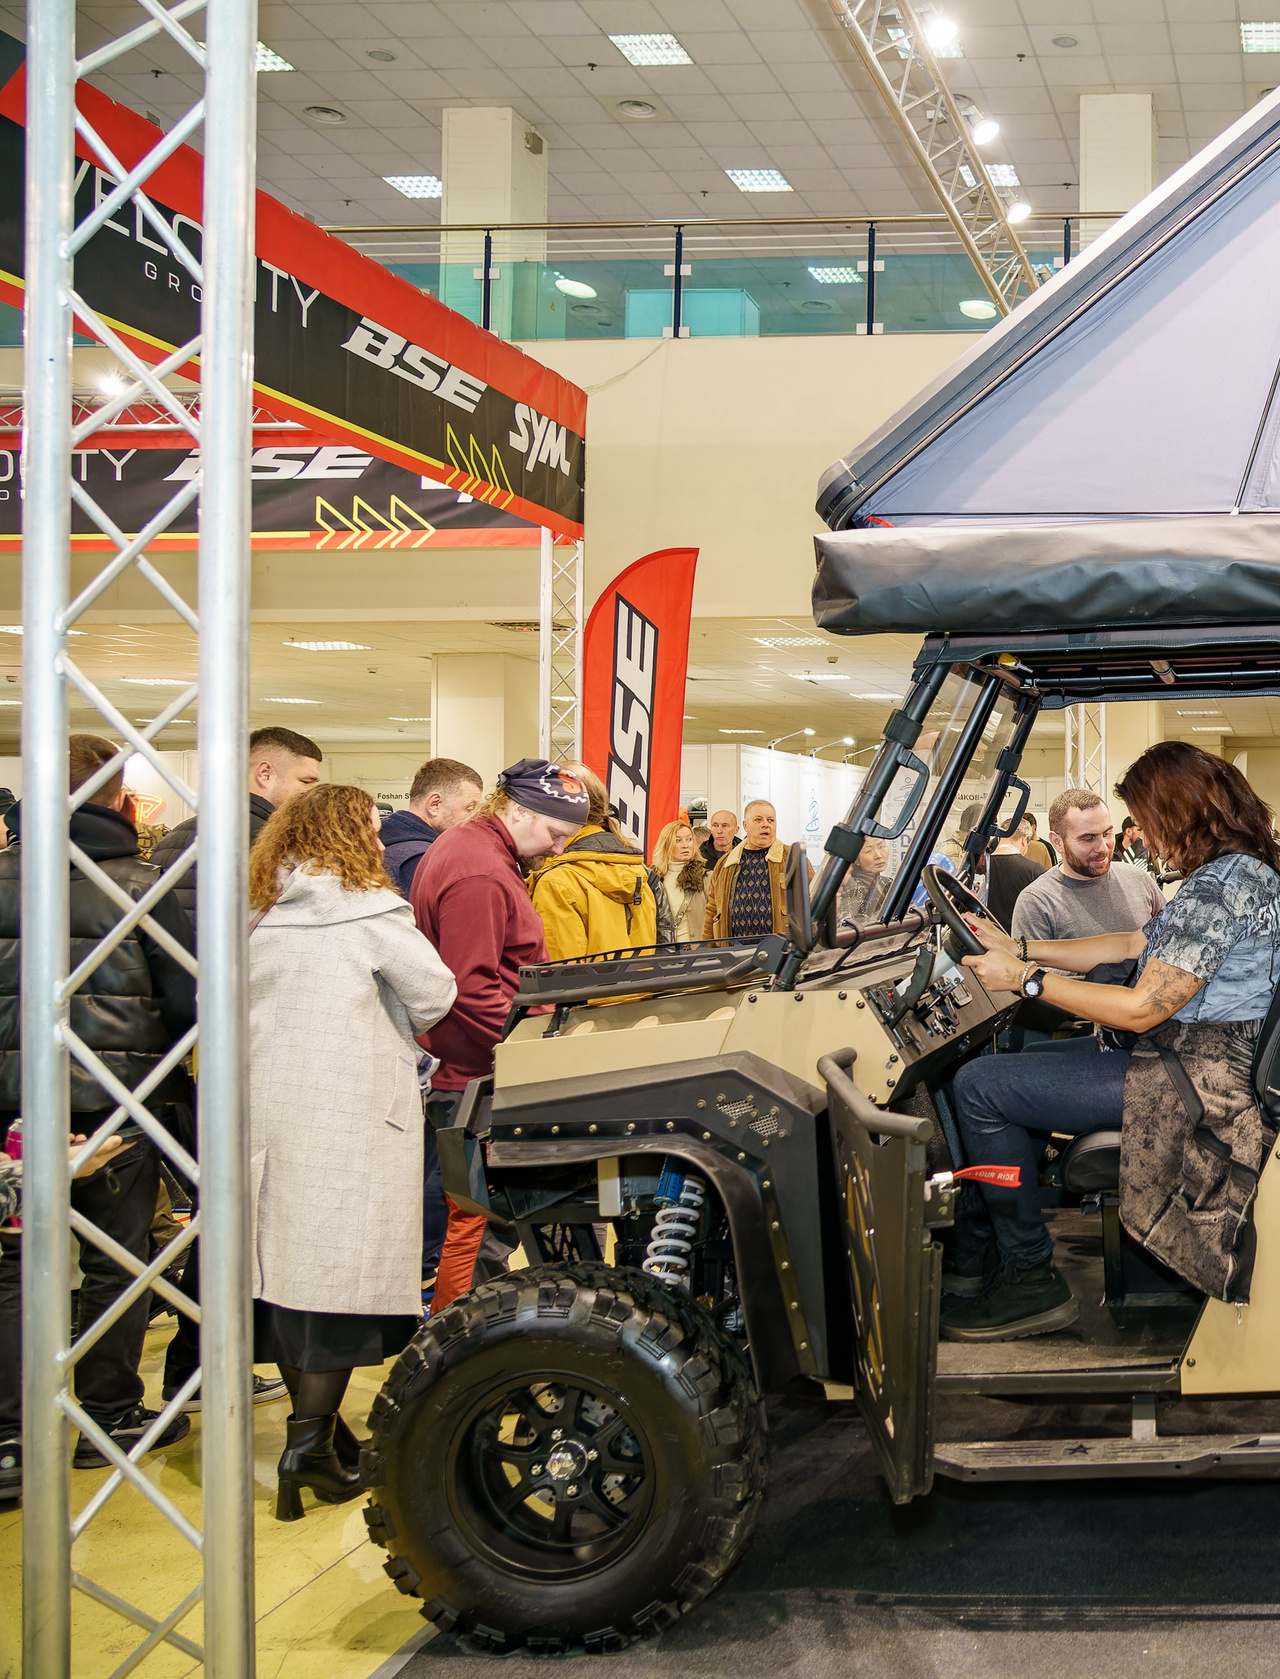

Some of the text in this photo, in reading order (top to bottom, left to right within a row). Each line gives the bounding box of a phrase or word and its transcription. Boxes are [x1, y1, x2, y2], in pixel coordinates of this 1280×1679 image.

[340, 316, 488, 414] BSE
[508, 402, 571, 477] SYM
[377, 792, 403, 800] Foshan
[997, 1173, 1016, 1182] RIDE
